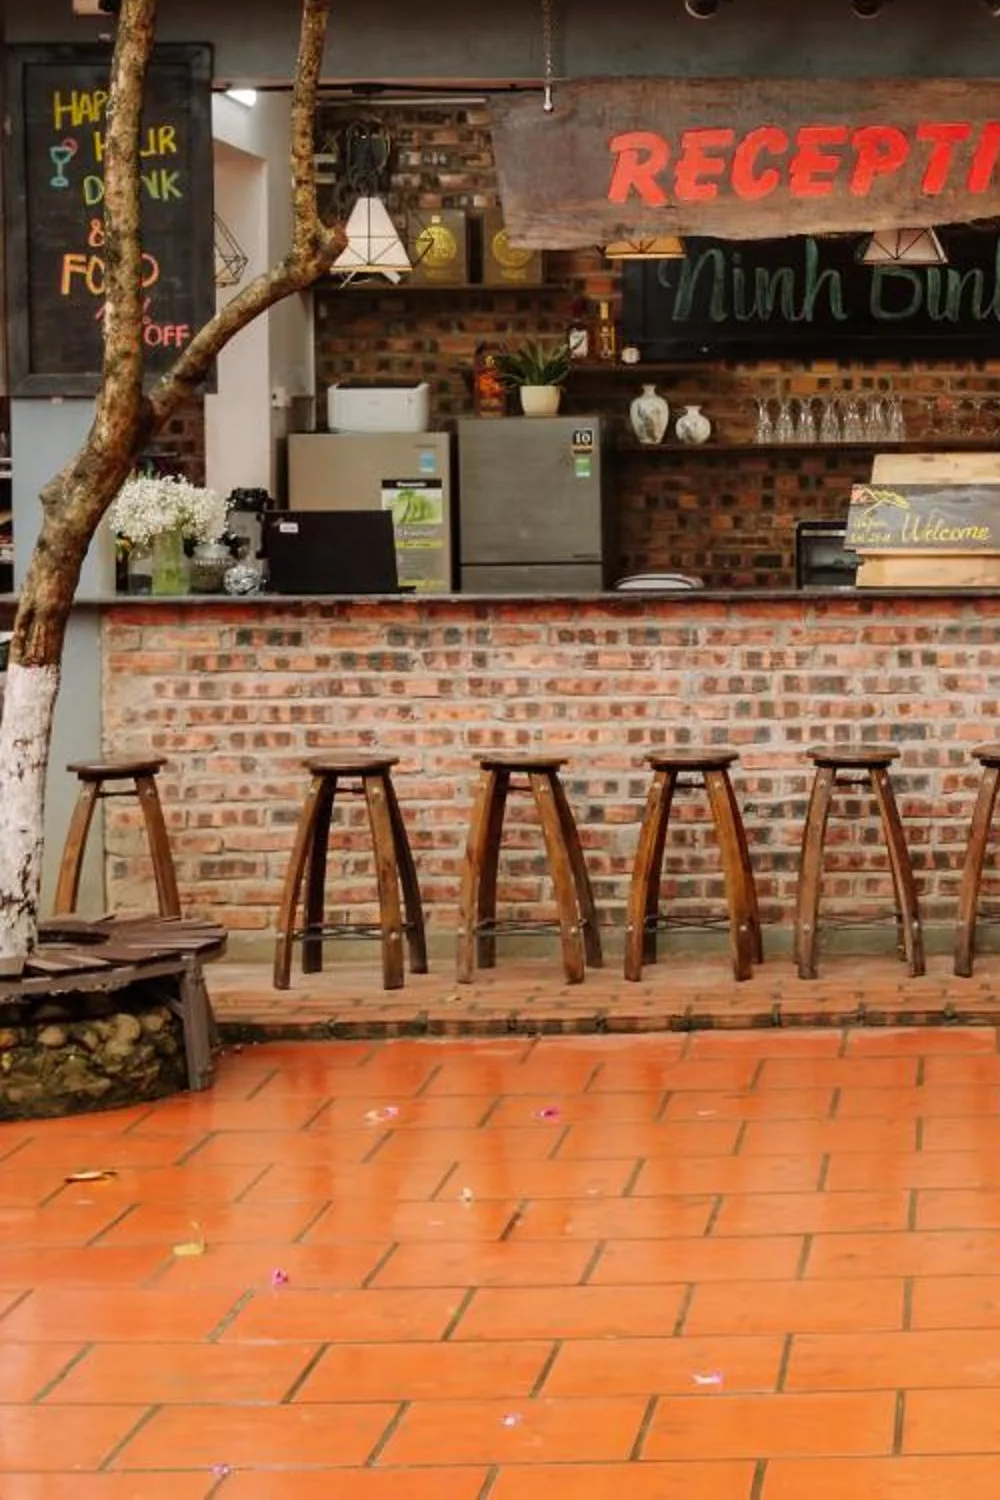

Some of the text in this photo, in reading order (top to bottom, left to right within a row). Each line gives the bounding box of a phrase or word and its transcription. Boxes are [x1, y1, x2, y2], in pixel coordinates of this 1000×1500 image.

[53, 89, 109, 131] HAP
[83, 168, 183, 206] DNK
[61, 252, 160, 295] FOD
[143, 323, 190, 347] OFF
[901, 512, 992, 544] Welcome
